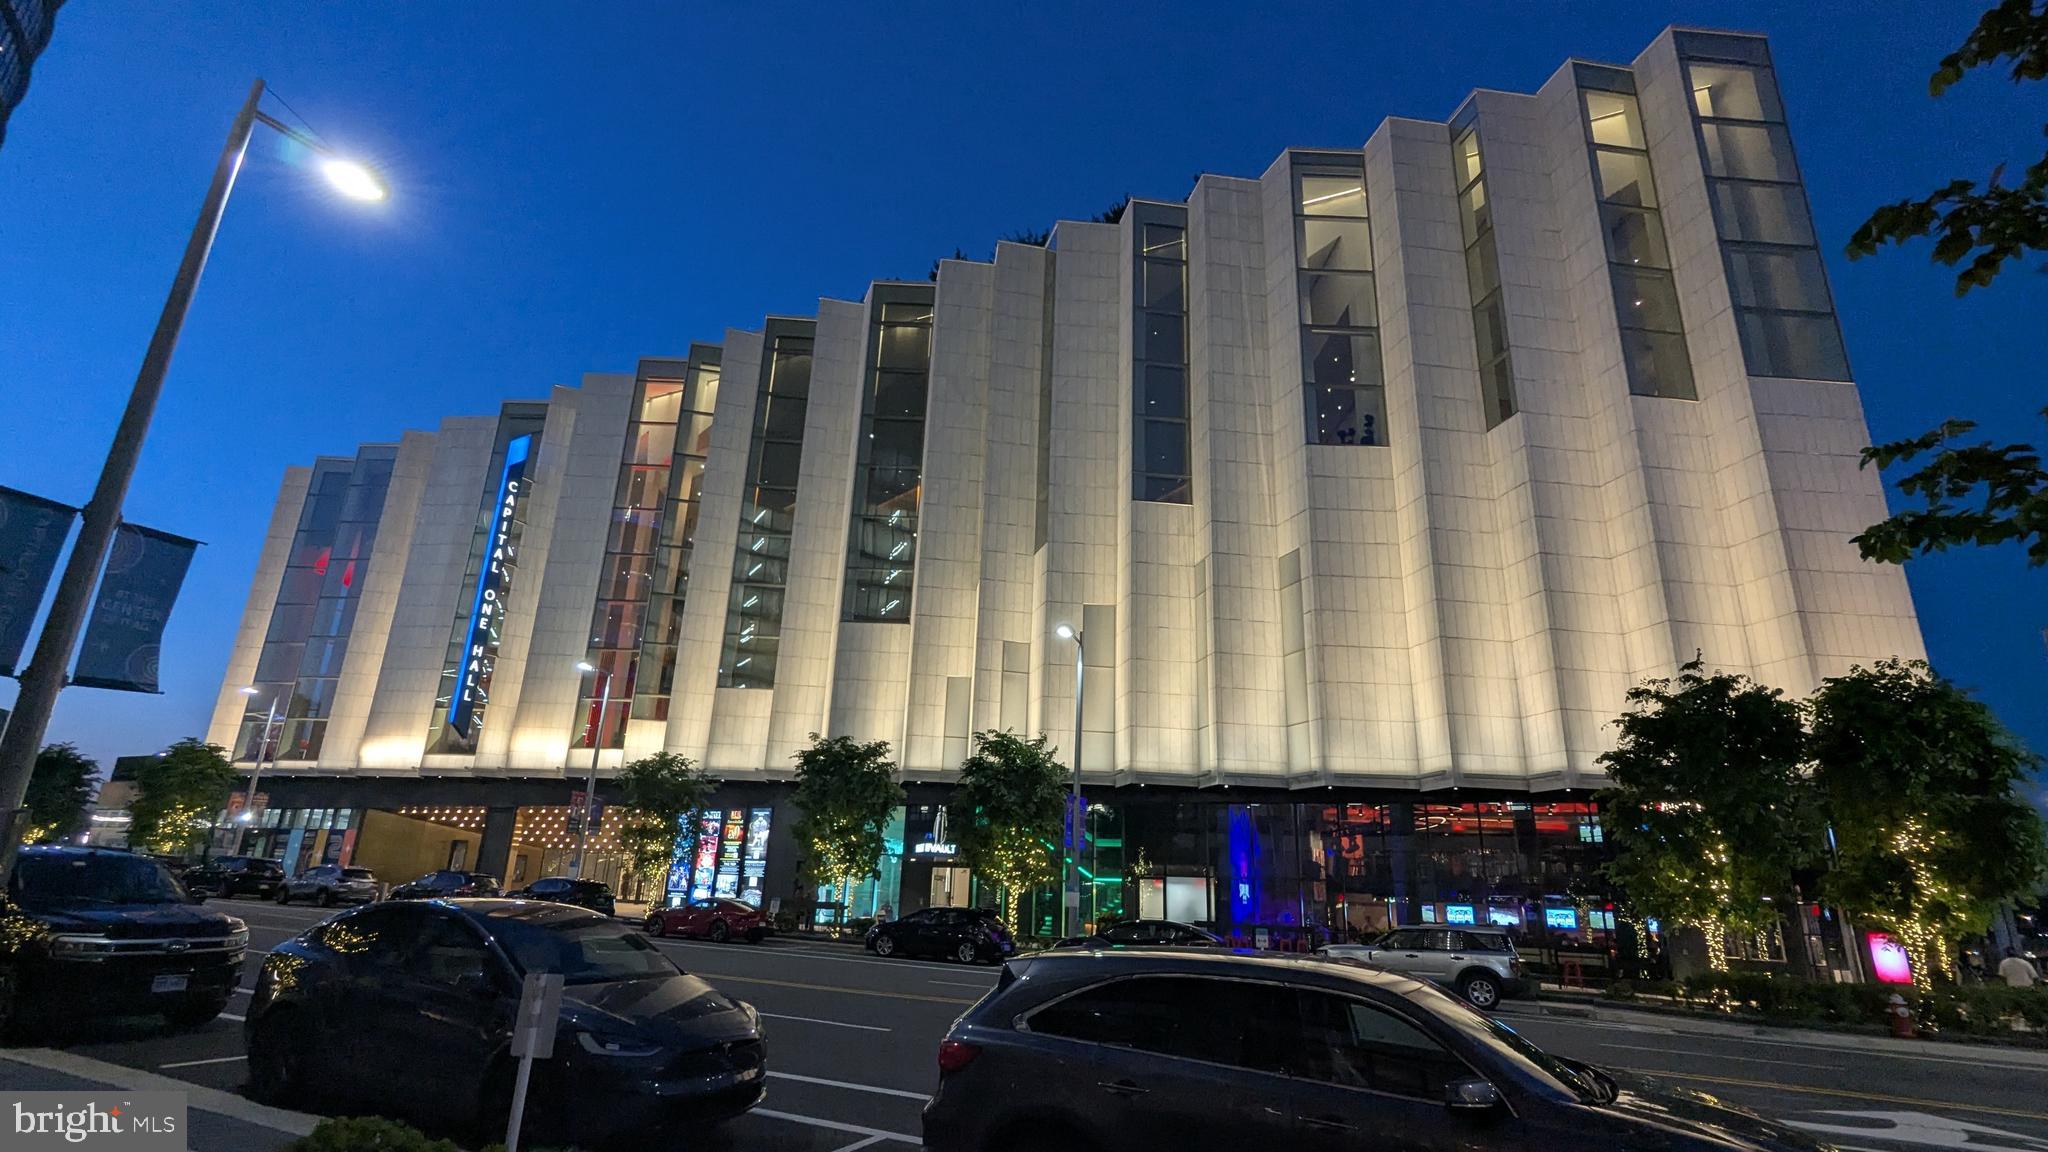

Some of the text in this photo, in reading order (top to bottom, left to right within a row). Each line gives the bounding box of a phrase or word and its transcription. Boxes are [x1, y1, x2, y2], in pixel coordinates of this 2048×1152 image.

[463, 481, 519, 702] CAPITAL ONE HALL
